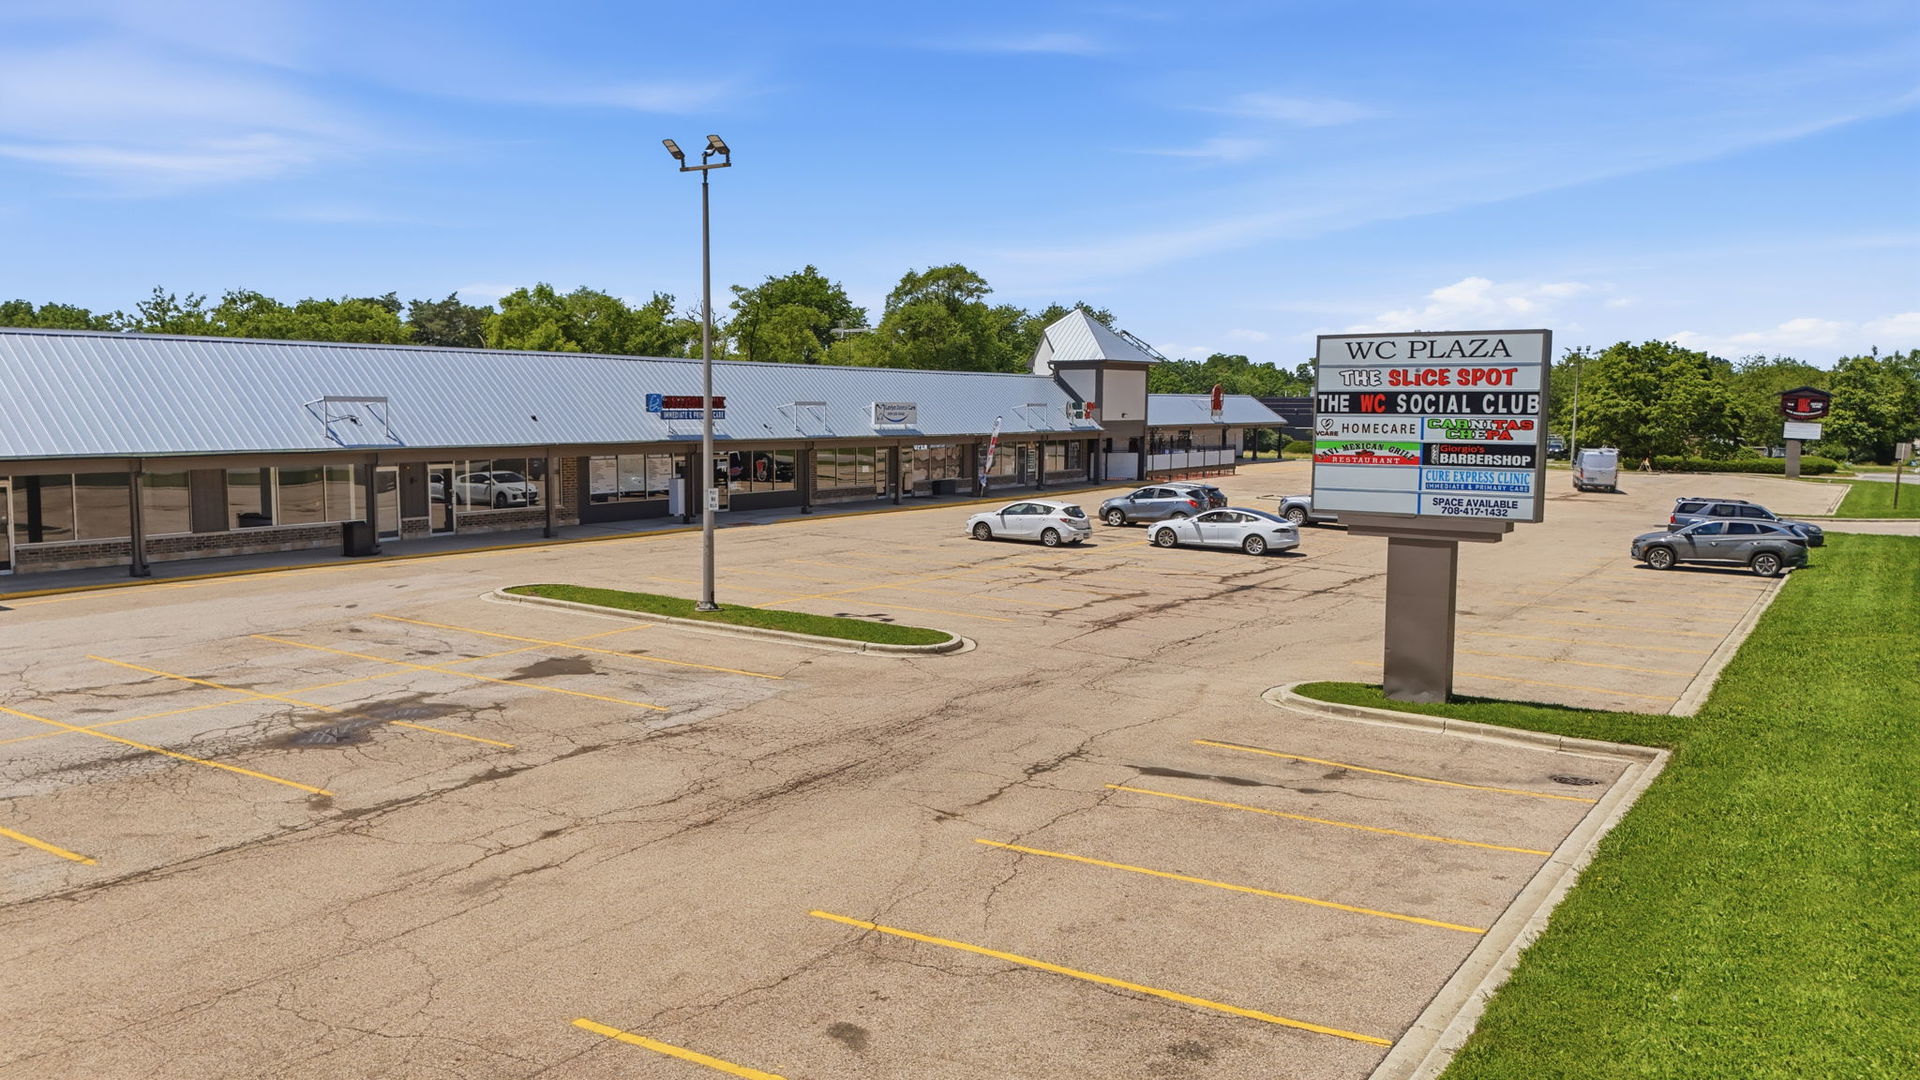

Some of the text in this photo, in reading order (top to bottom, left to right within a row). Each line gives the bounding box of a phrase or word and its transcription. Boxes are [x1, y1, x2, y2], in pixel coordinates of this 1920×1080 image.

[1345, 339, 1513, 360] WC PLAZA
[1339, 370, 1383, 387] THE
[1457, 367, 1519, 387] SPOT
[1318, 393, 1540, 414] THE WC SOCIAL CLUB
[1341, 423, 1416, 434] HOMECARE
[1427, 418, 1535, 430] CARNITAS
[1445, 429, 1514, 440] CHEPA
[1341, 443, 1385, 452] MEXICAN
[1388, 446, 1415, 460] GRILL
[1440, 444, 1486, 453] Giorgio's
[1332, 456, 1401, 464] RESTAURANT
[1440, 453, 1532, 467] BARBERSHOP
[1425, 470, 1531, 485] CURE EXPRESS CLINIC
[1432, 497, 1519, 509] SPACE AVAILABLE
